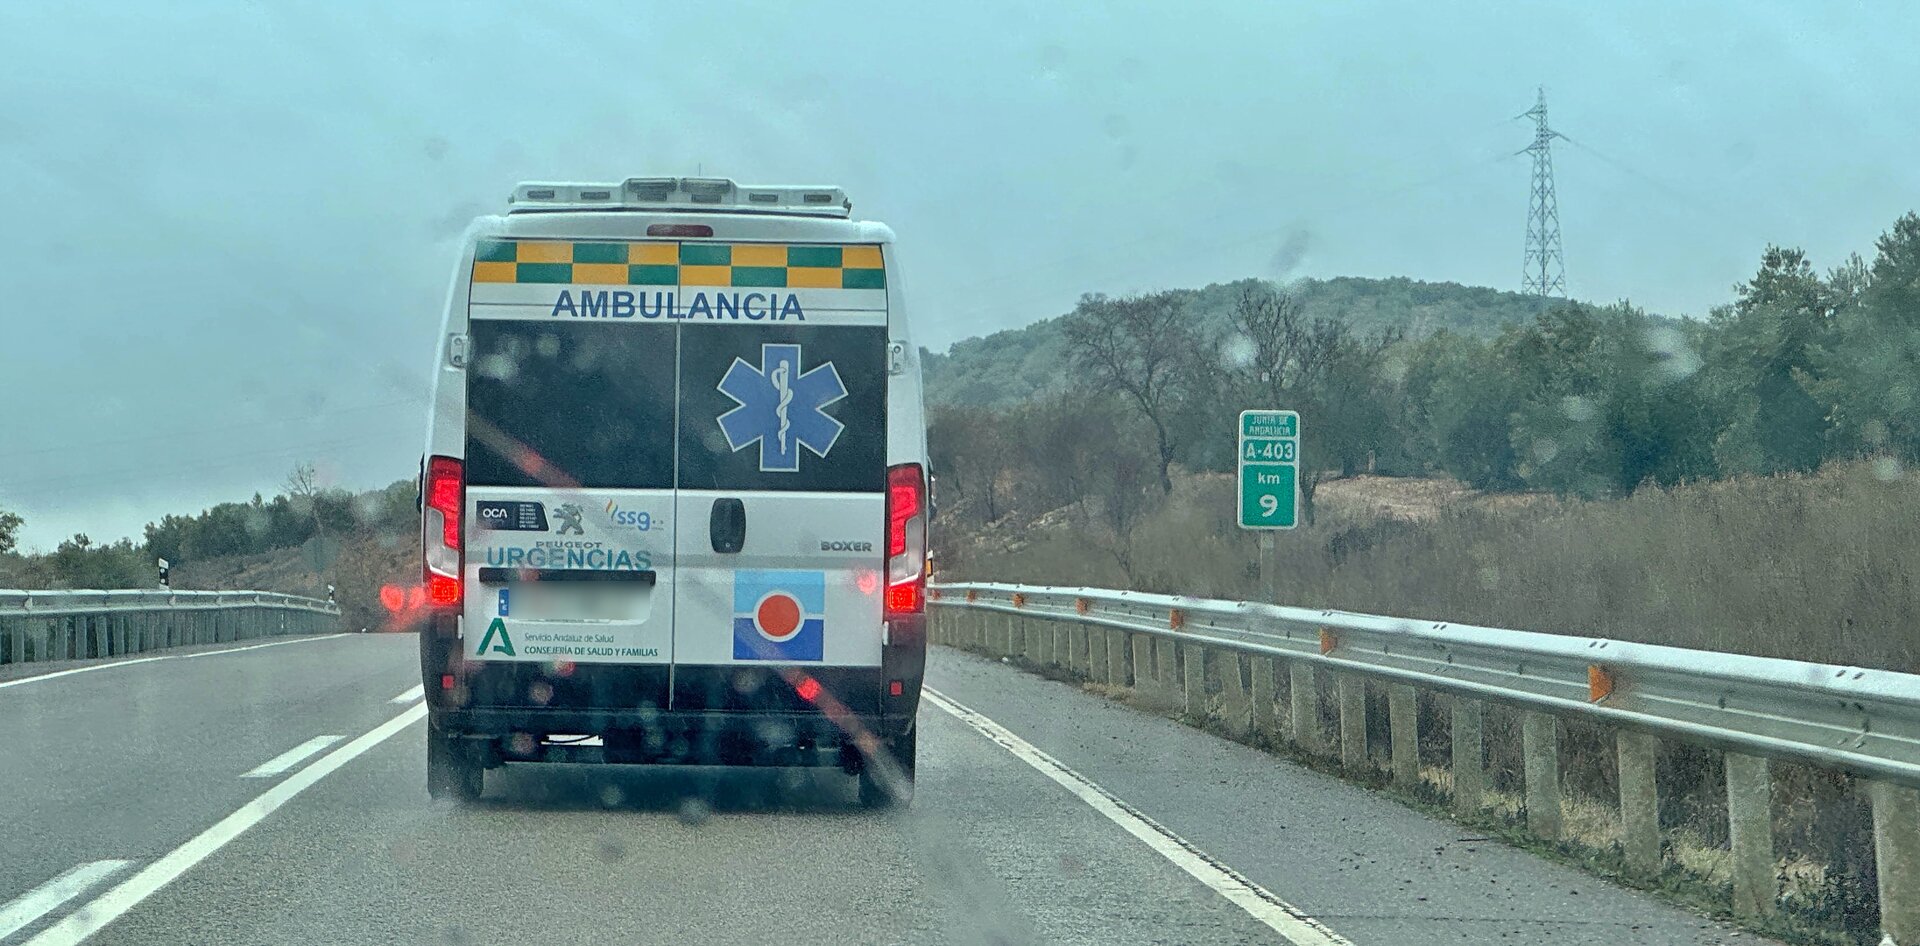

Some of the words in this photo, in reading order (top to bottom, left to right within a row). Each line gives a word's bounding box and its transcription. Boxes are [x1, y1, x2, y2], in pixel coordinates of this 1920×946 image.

[551, 289, 805, 321] AMBULANCIA
[1251, 415, 1275, 425] JUNTA
[1245, 442, 1293, 459] A-403
[1257, 472, 1280, 484] km
[1259, 494, 1278, 517] 9
[482, 508, 508, 518] OCA
[536, 541, 602, 549] PEUGEOT
[820, 540, 872, 552] BOXER
[487, 547, 652, 570] URGENCIAS
[524, 632, 552, 642] Servicio
[553, 633, 582, 643] Andaluz
[583, 634, 594, 643] de
[594, 634, 615, 643] Salud
[574, 646, 586, 655] DE
[587, 647, 614, 656] SALUD
[615, 647, 621, 656] Y
[621, 648, 659, 657] FAMILIAS
